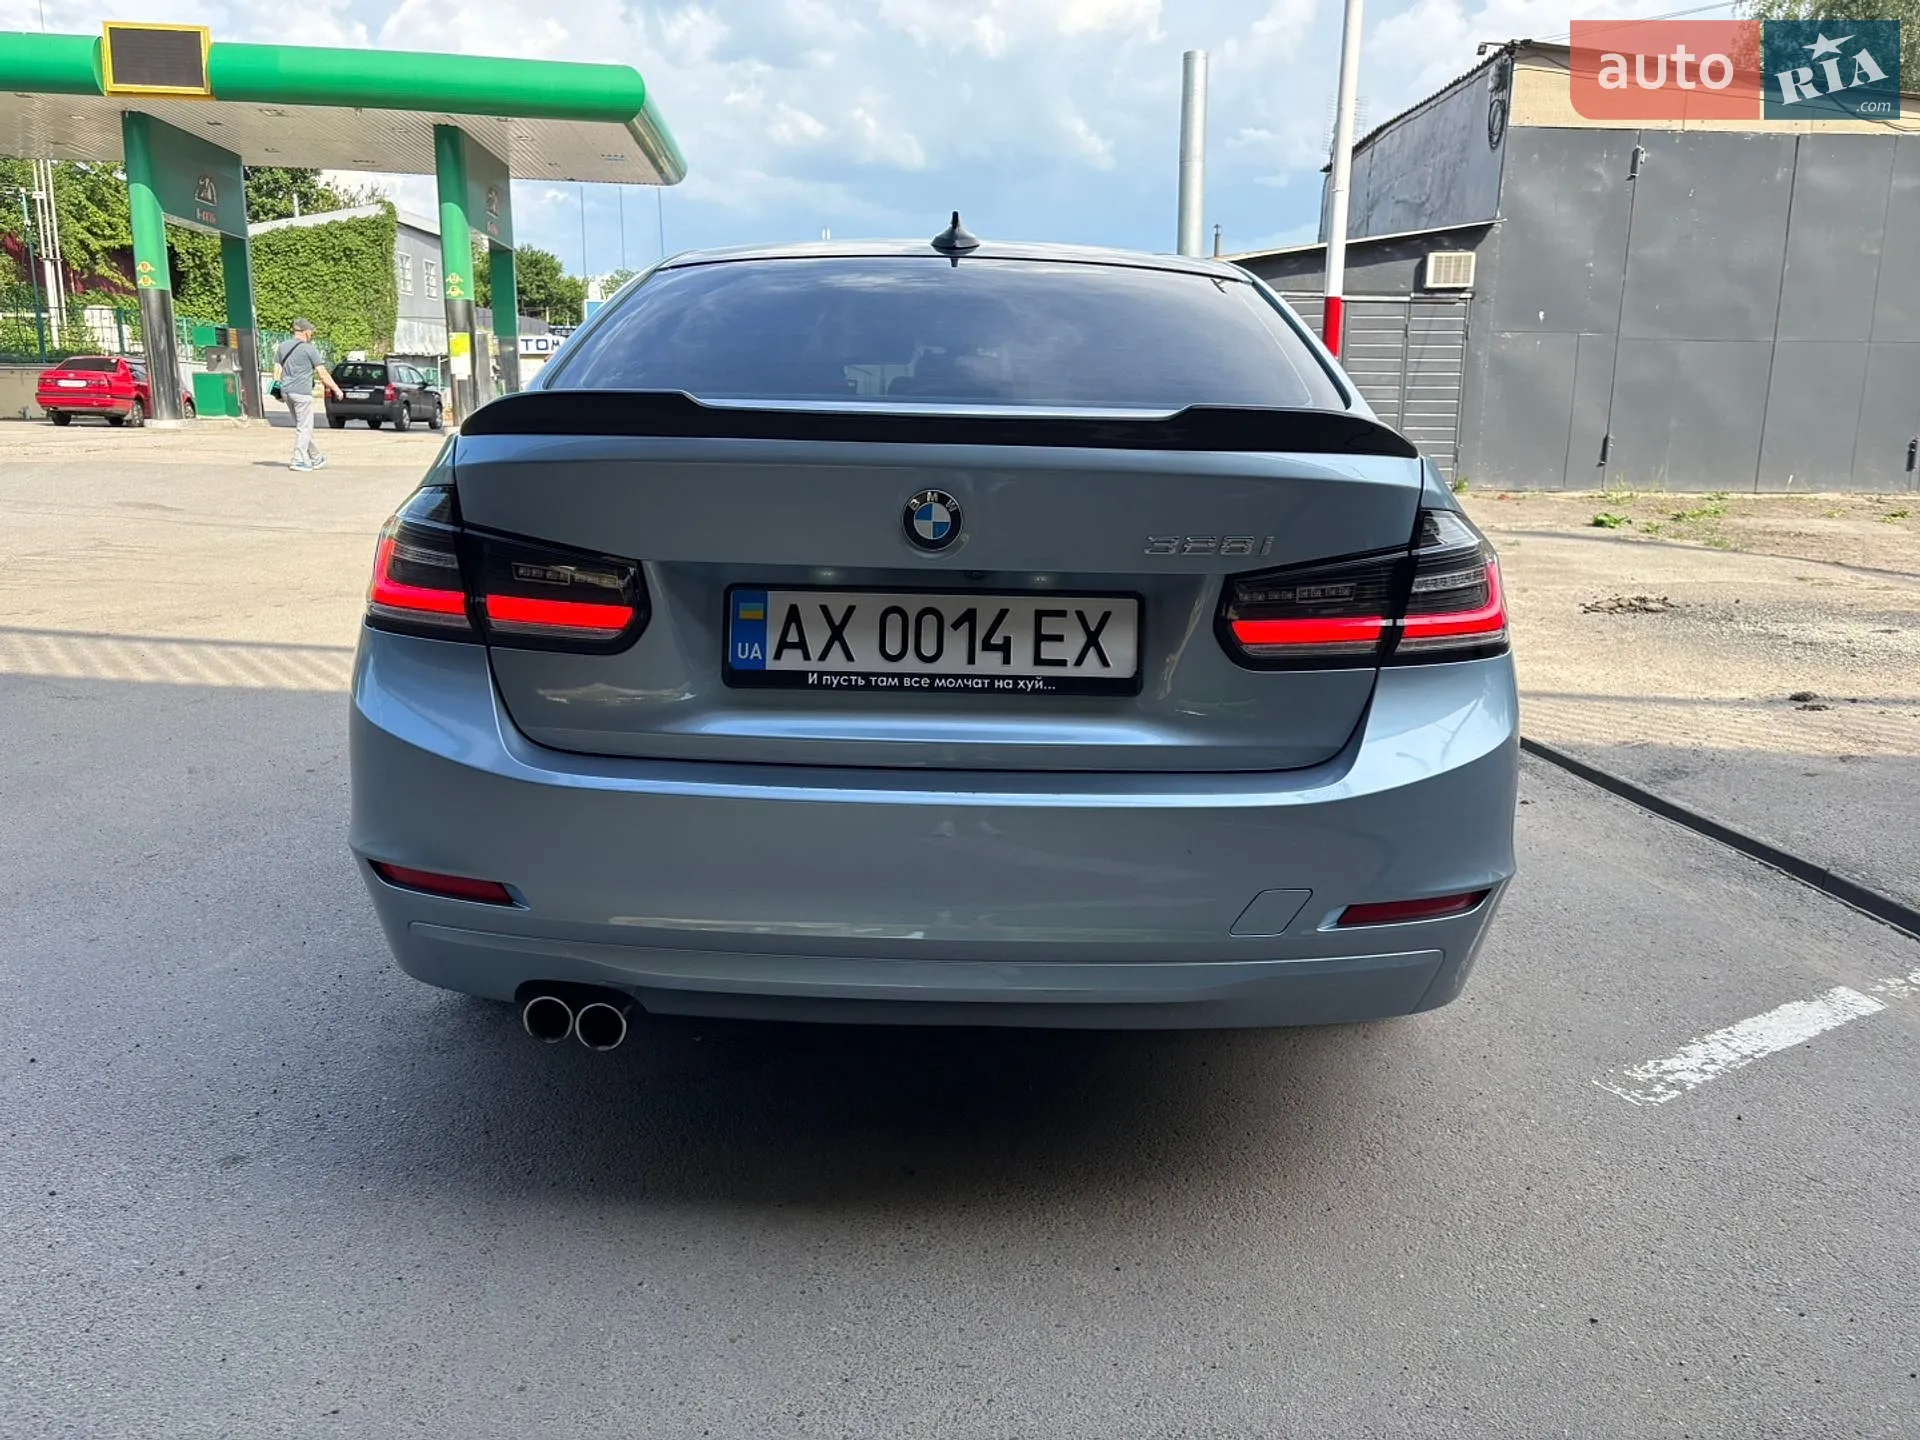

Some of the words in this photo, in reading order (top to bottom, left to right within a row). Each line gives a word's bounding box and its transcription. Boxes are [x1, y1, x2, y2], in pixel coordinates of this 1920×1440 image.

[907, 491, 957, 512] BMW
[1143, 535, 1274, 555] 328i
[773, 603, 857, 662] AX
[879, 605, 1012, 665] 0014
[1034, 609, 1112, 668] EX
[737, 642, 762, 659] UA
[808, 672, 818, 685] И
[822, 675, 866, 688] пусть
[869, 677, 899, 687] там
[903, 677, 930, 687] все
[934, 678, 990, 688] молчат
[994, 679, 1013, 689] на
[1017, 675, 1056, 692] хуй...
